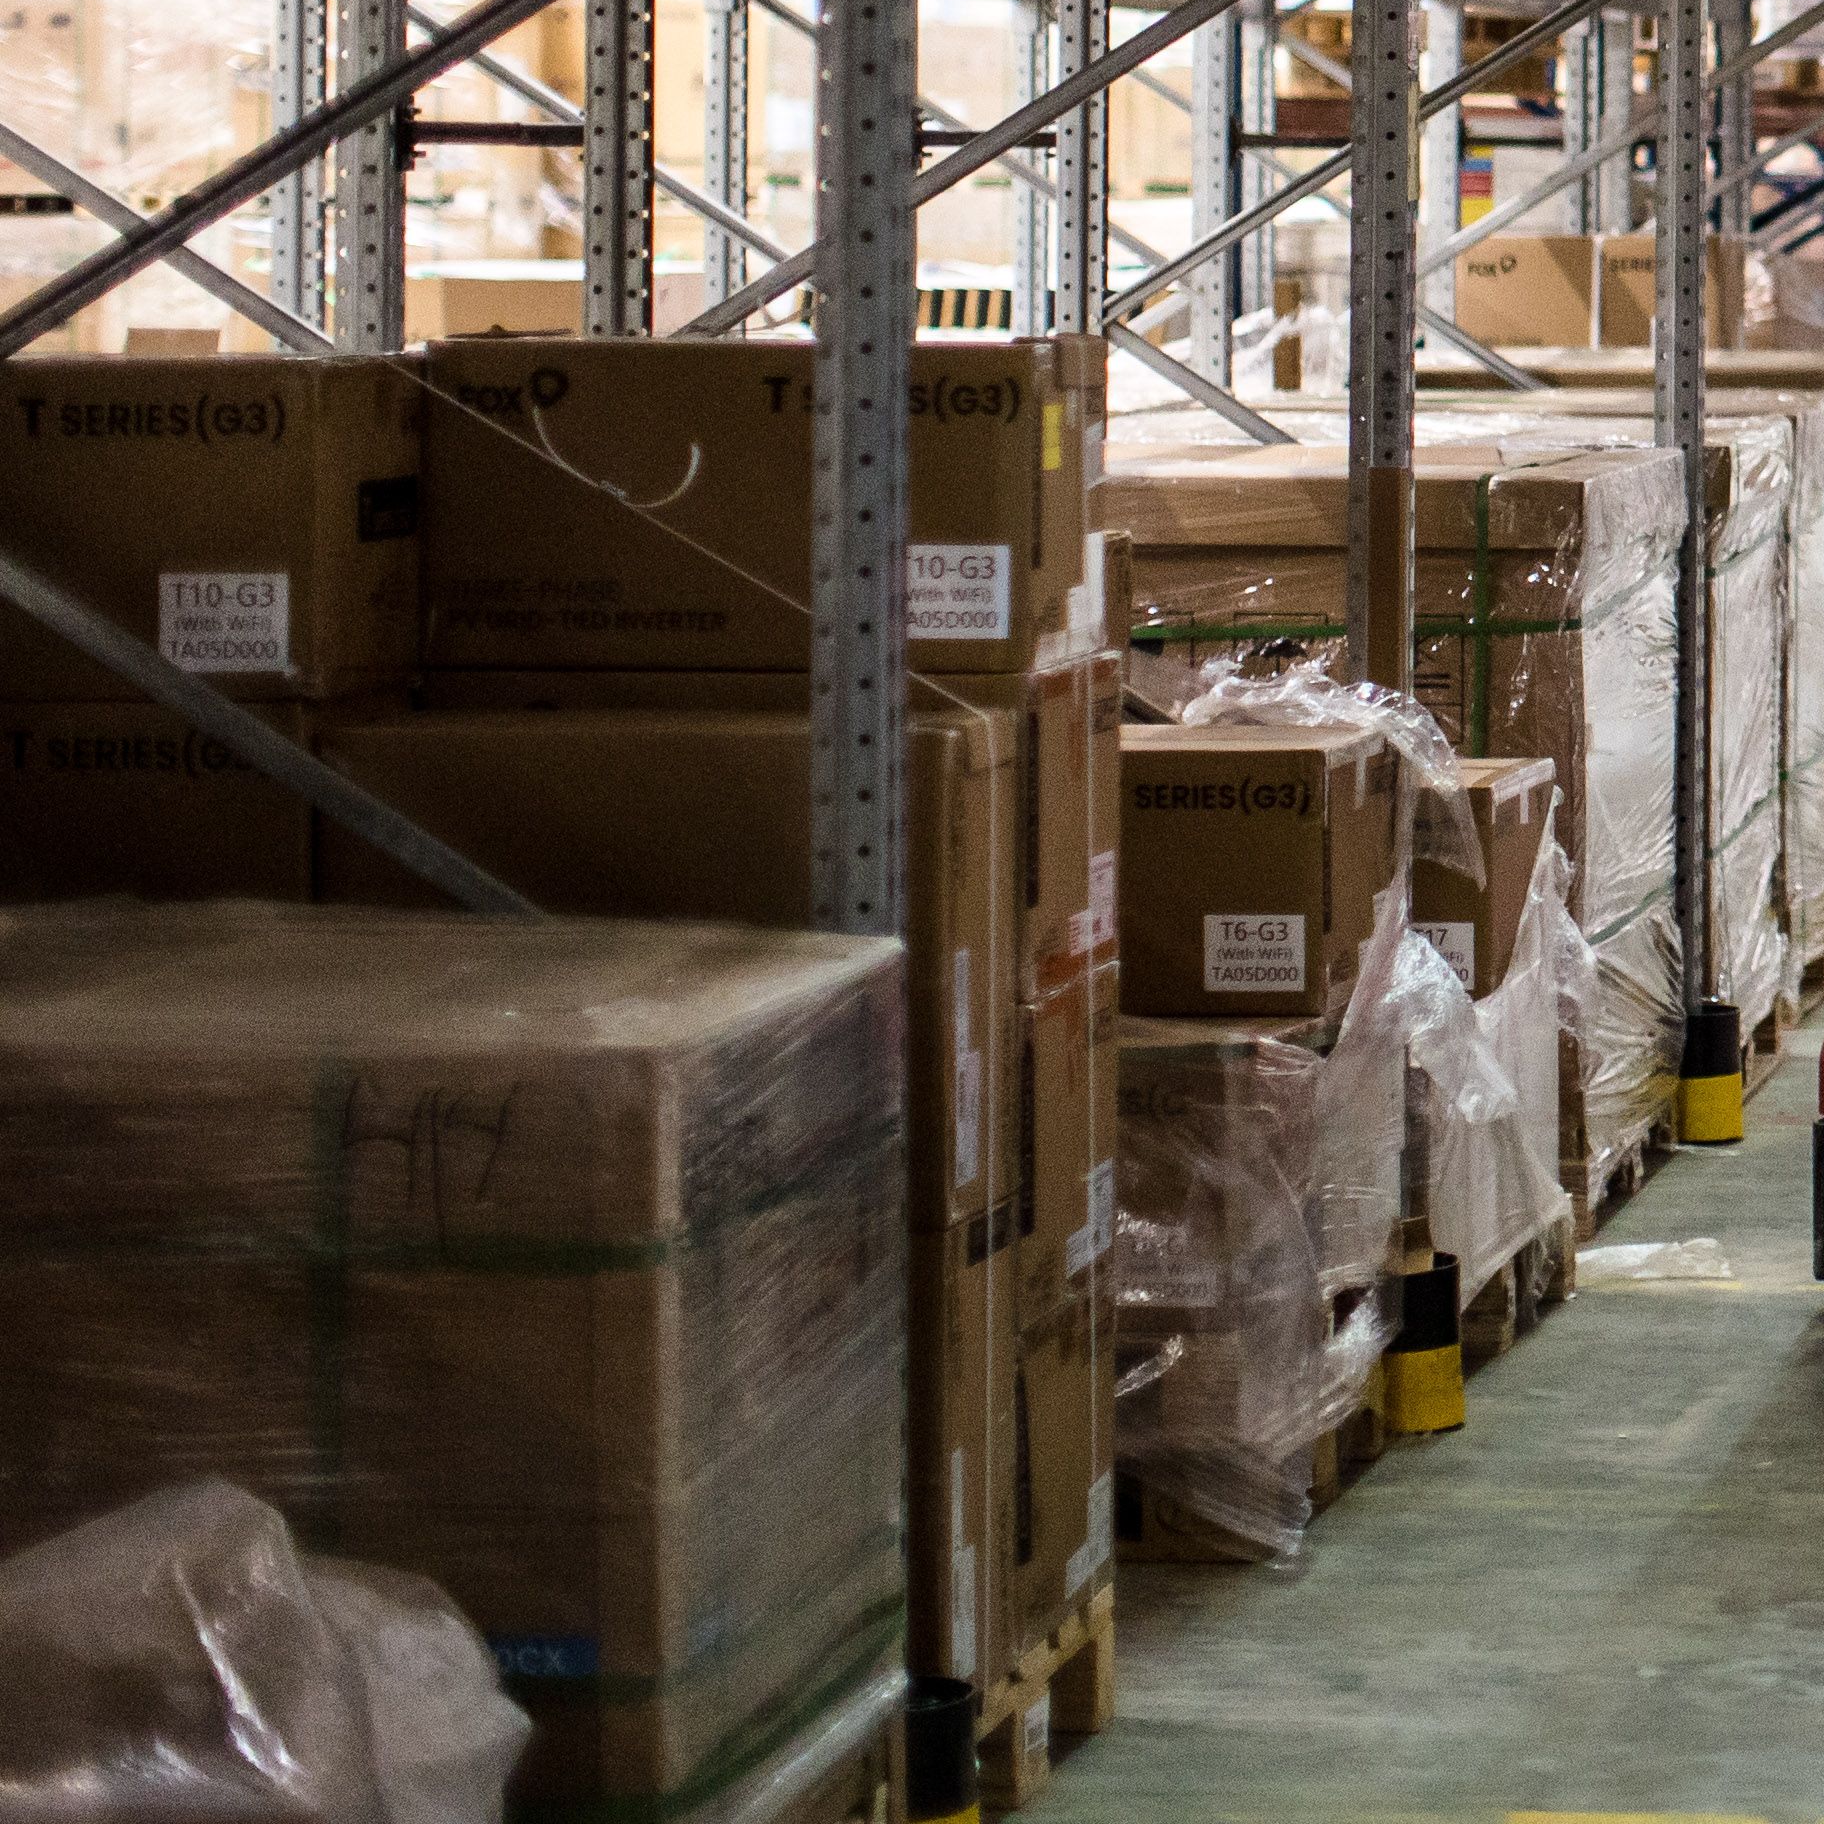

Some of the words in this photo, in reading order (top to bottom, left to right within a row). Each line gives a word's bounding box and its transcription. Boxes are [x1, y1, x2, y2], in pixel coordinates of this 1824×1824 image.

[20, 398, 46, 438] T
[59, 393, 287, 444] SERIES(G3)
[170, 582, 274, 609] T10-G3
[10, 731, 31, 768] T
[50, 729, 232, 777] SERIES(G
[1134, 777, 1313, 816] SERIES(G3)
[1220, 921, 1289, 941] T6-G3
